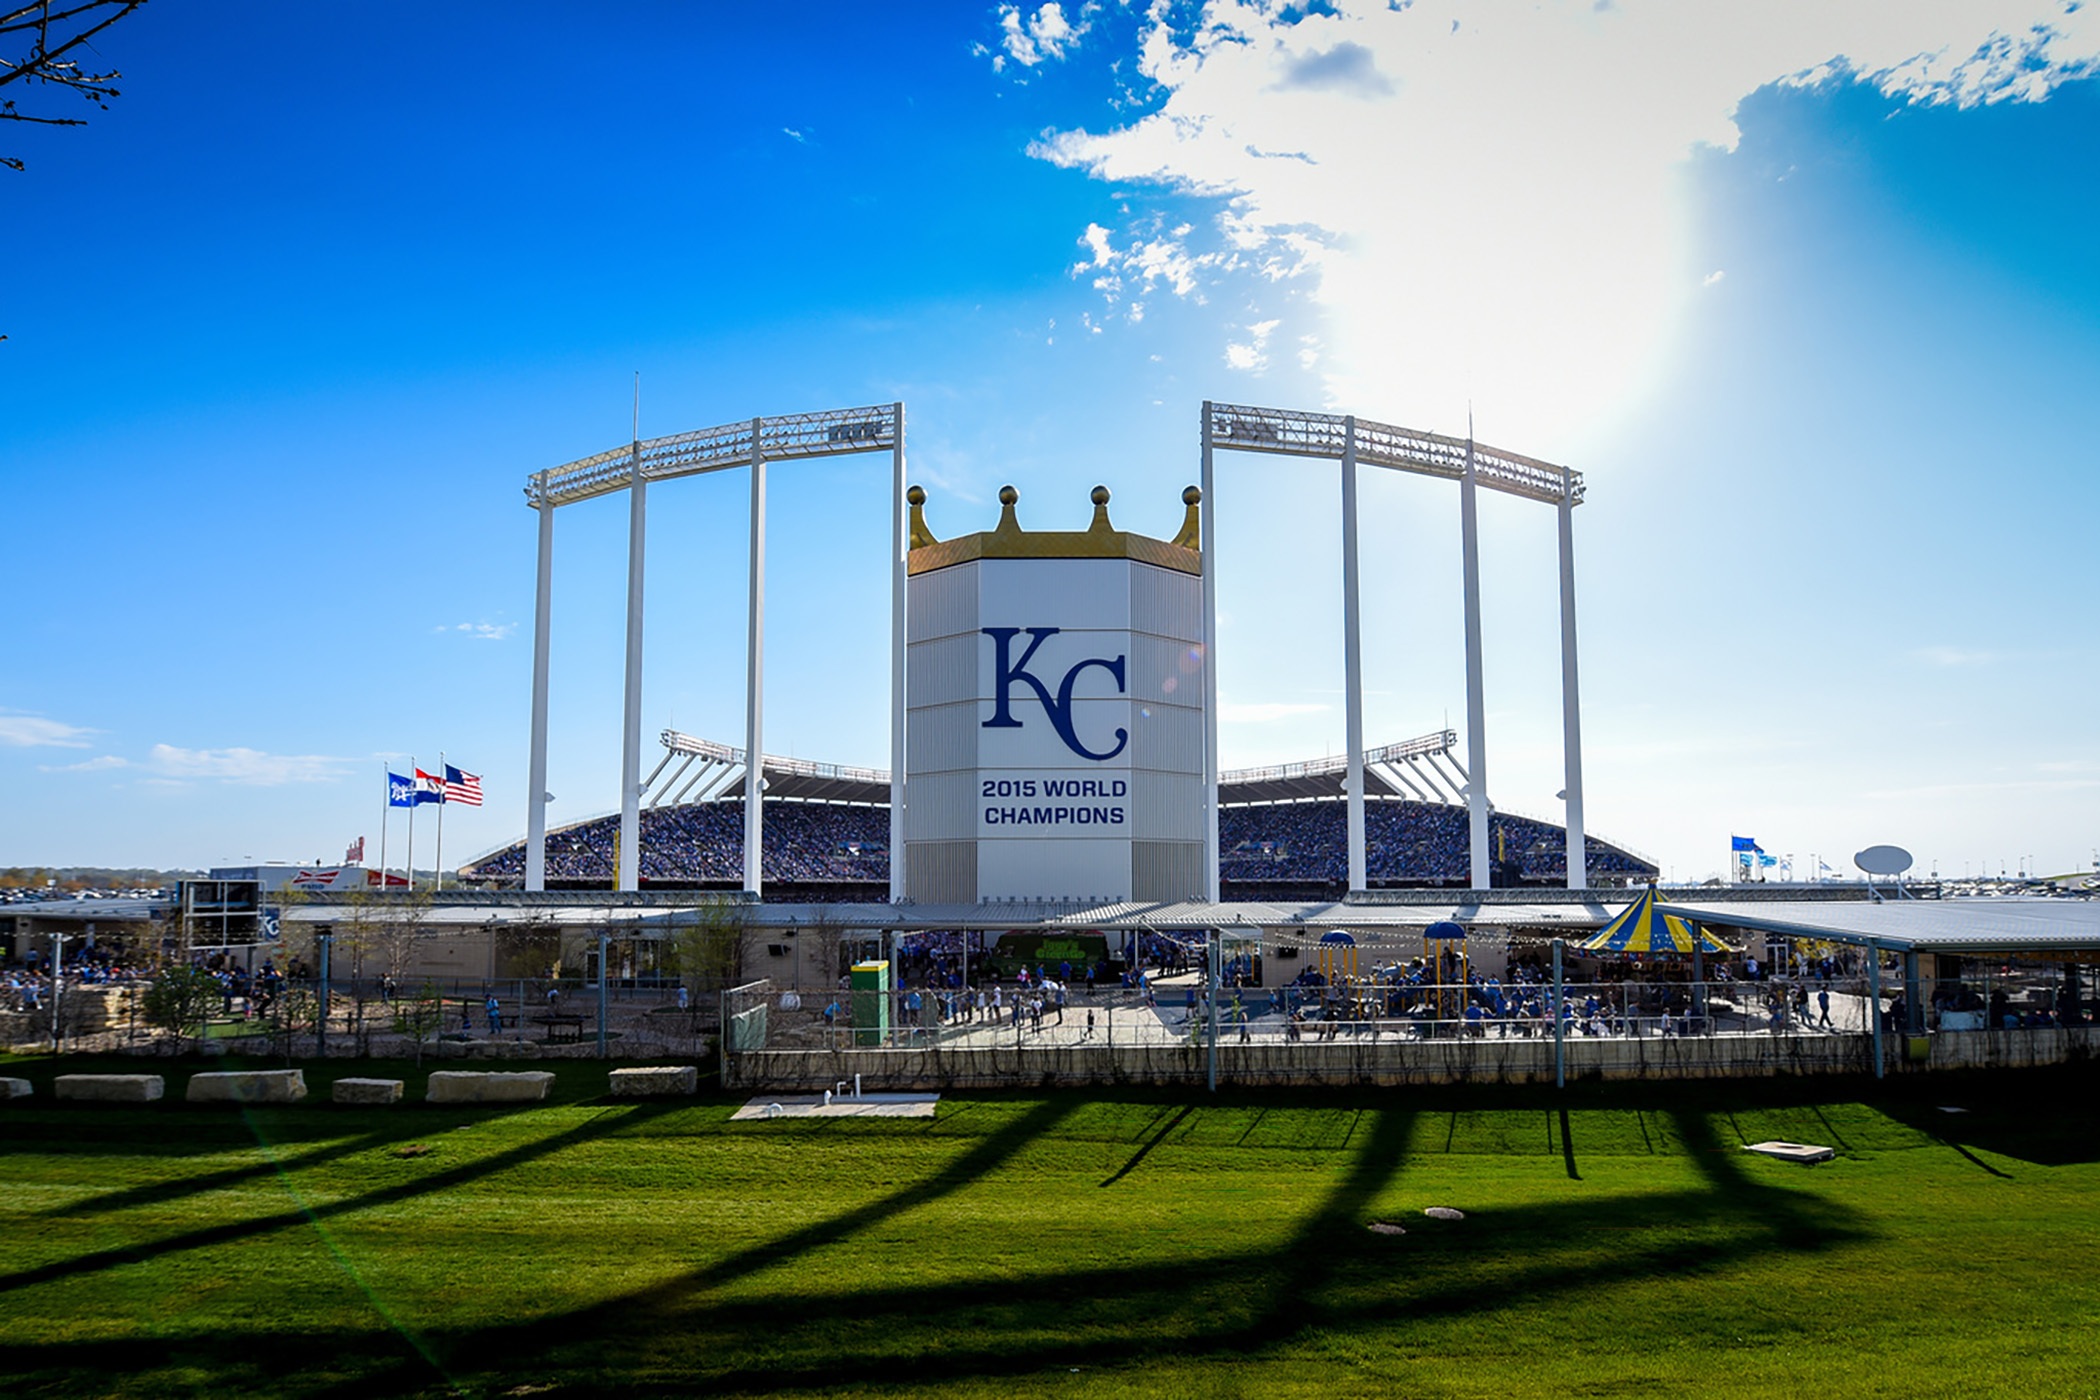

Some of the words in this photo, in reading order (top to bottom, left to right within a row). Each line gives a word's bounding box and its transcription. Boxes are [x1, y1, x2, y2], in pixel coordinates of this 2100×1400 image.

[981, 627, 1128, 761] KC
[982, 780, 1036, 797] 2015
[1043, 780, 1127, 797] WORLD
[985, 807, 1124, 824] CHAMPIONS
